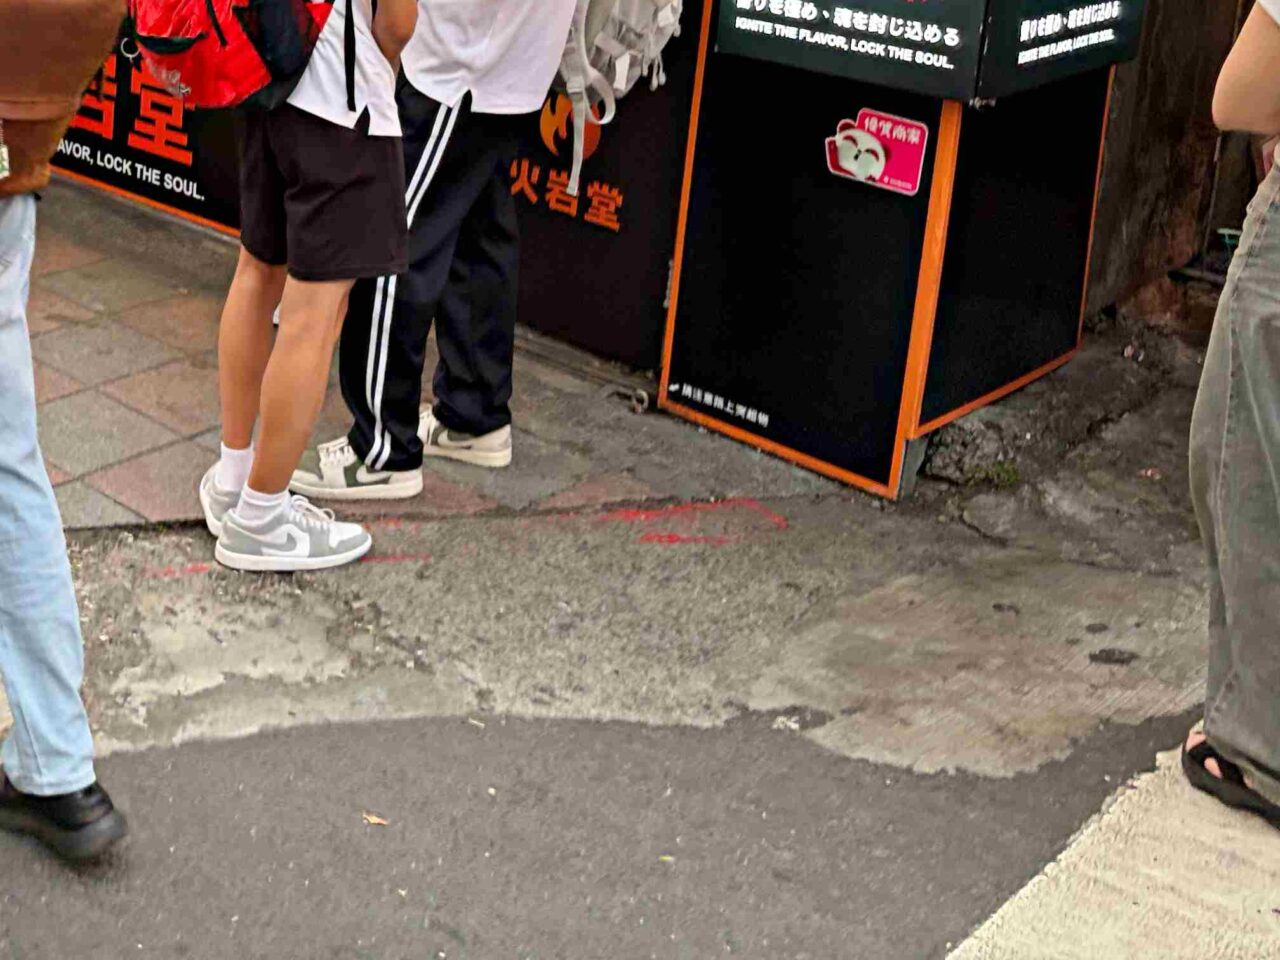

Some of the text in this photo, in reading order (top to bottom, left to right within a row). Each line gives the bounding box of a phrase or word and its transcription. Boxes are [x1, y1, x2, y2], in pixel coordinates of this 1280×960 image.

[735, 16, 773, 35] IGNITE
[774, 24, 798, 40] THE
[851, 39, 887, 57] LOCK
[888, 45, 913, 62] THE
[915, 50, 955, 70] SOUL.
[96, 150, 133, 176] LOCK
[134, 163, 162, 186] THE
[163, 173, 205, 201] SOUL.
[509, 158, 624, 232] 火岩堂
